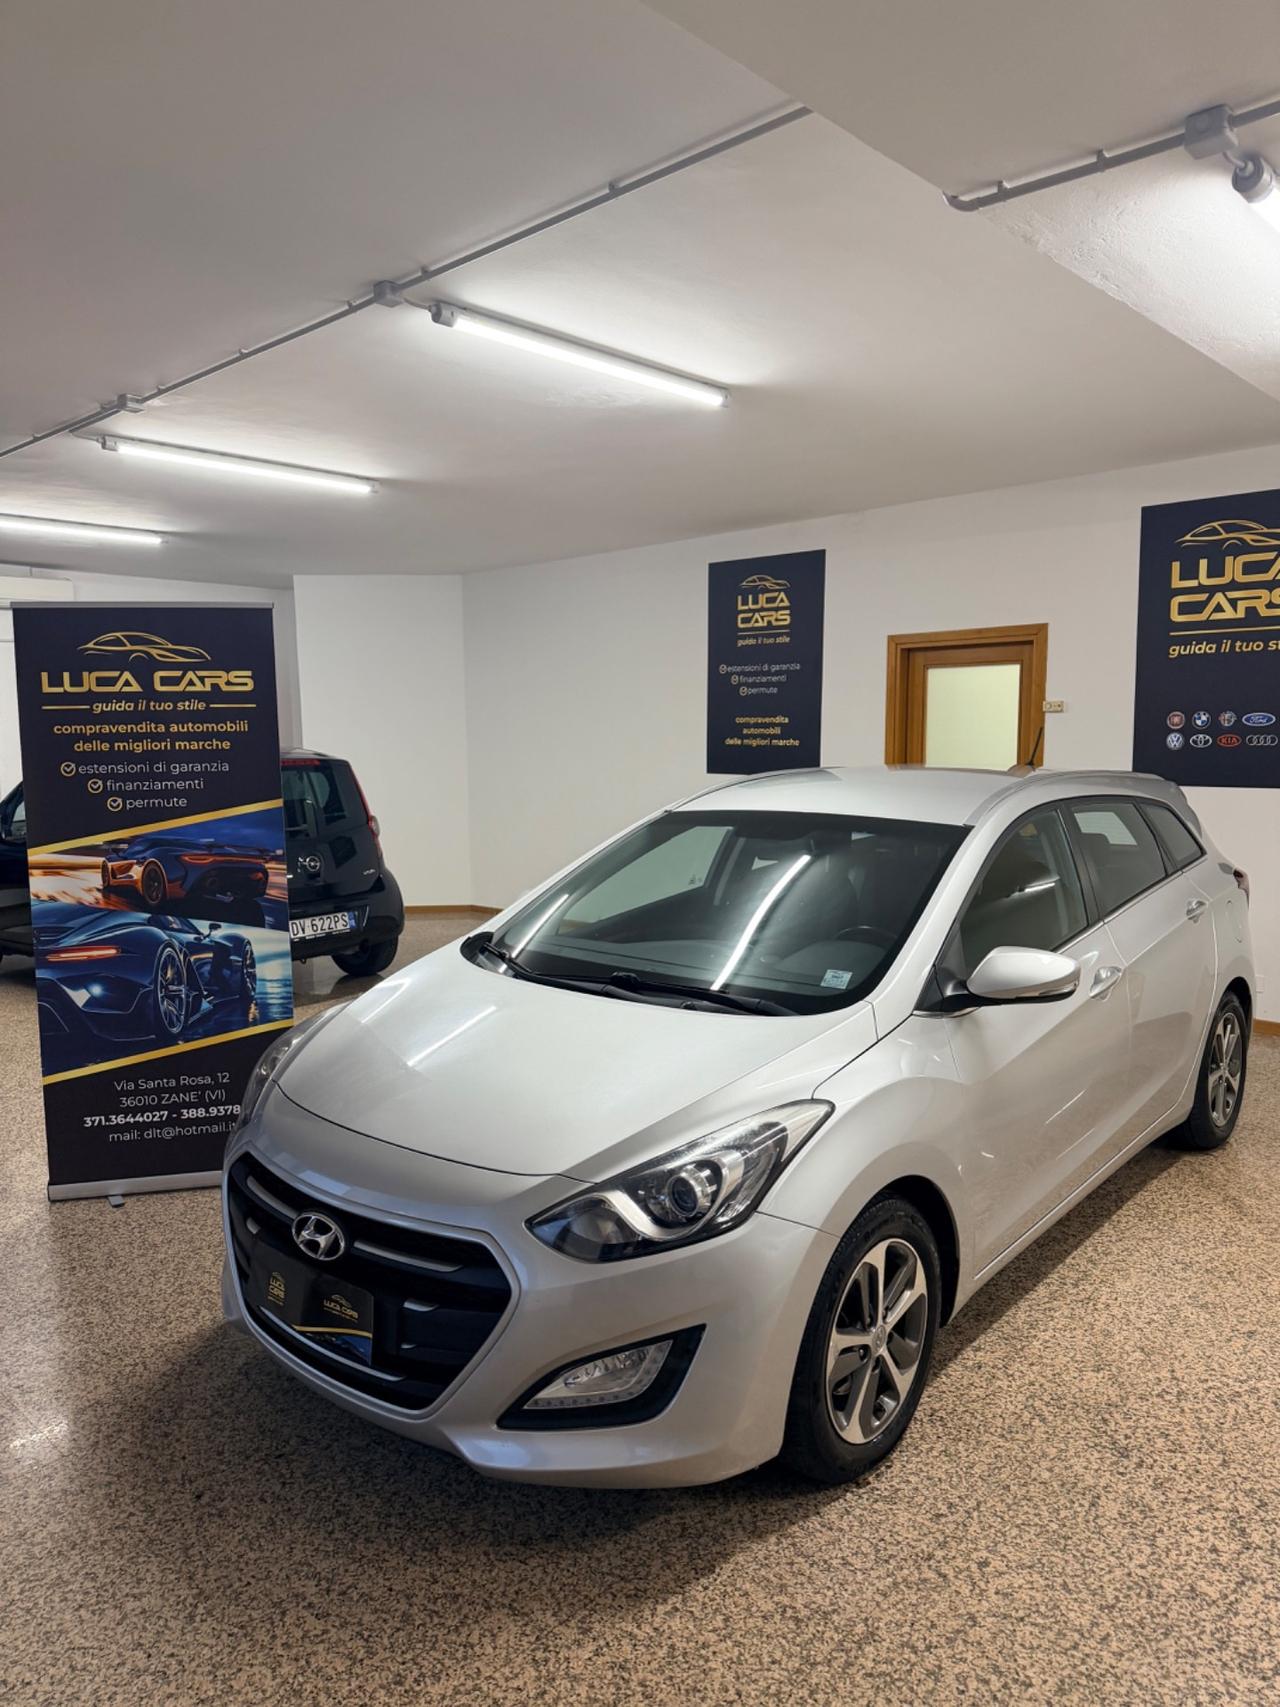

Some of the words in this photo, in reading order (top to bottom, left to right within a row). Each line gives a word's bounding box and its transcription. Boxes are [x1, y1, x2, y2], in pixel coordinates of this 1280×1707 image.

[738, 592, 790, 610] LUCA
[1170, 589, 1280, 622] CAR
[738, 610, 790, 628] CARS
[738, 637, 756, 647] guida
[758, 636, 762, 644] il
[776, 635, 790, 643] stile
[1169, 641, 1216, 658] guida
[1221, 640, 1231, 653] il
[1235, 639, 1263, 652] tuo
[728, 663, 761, 672] estensioni
[762, 663, 769, 671] di
[771, 663, 800, 672] garanzia
[41, 671, 143, 693] LUCA
[154, 671, 254, 692] CARS
[740, 674, 786, 683] finanziamenti
[748, 687, 778, 695] permute
[93, 700, 134, 713] guida
[138, 700, 145, 711] il
[150, 701, 172, 711] tuo
[176, 700, 206, 710] stile
[736, 716, 789, 724] compravendita
[54, 722, 165, 737] compravendita
[170, 720, 248, 732] automobili
[743, 726, 781, 735] automobili
[74, 740, 110, 751] delle
[115, 739, 170, 753] migliori
[176, 739, 231, 750] marche
[725, 738, 741, 746] delle
[744, 738, 770, 747] migliori
[79, 762, 150, 774] estensioni
[154, 762, 166, 772] di
[170, 762, 229, 774] garanzia
[107, 779, 204, 791] finanziamenti
[126, 798, 187, 809] permute
[291, 921, 305, 936] DV
[311, 914, 348, 932] 622PS
[114, 1079, 135, 1091] Via
[138, 1078, 176, 1090] Santa
[180, 1075, 214, 1087] Rosa,
[217, 1072, 230, 1083] 12
[120, 1095, 157, 1108] 36010
[205, 1089, 226, 1102] (VI)
[84, 1110, 168, 1128] 371.3644027
[181, 1104, 240, 1119] 388.9378
[110, 1129, 141, 1142] mail:
